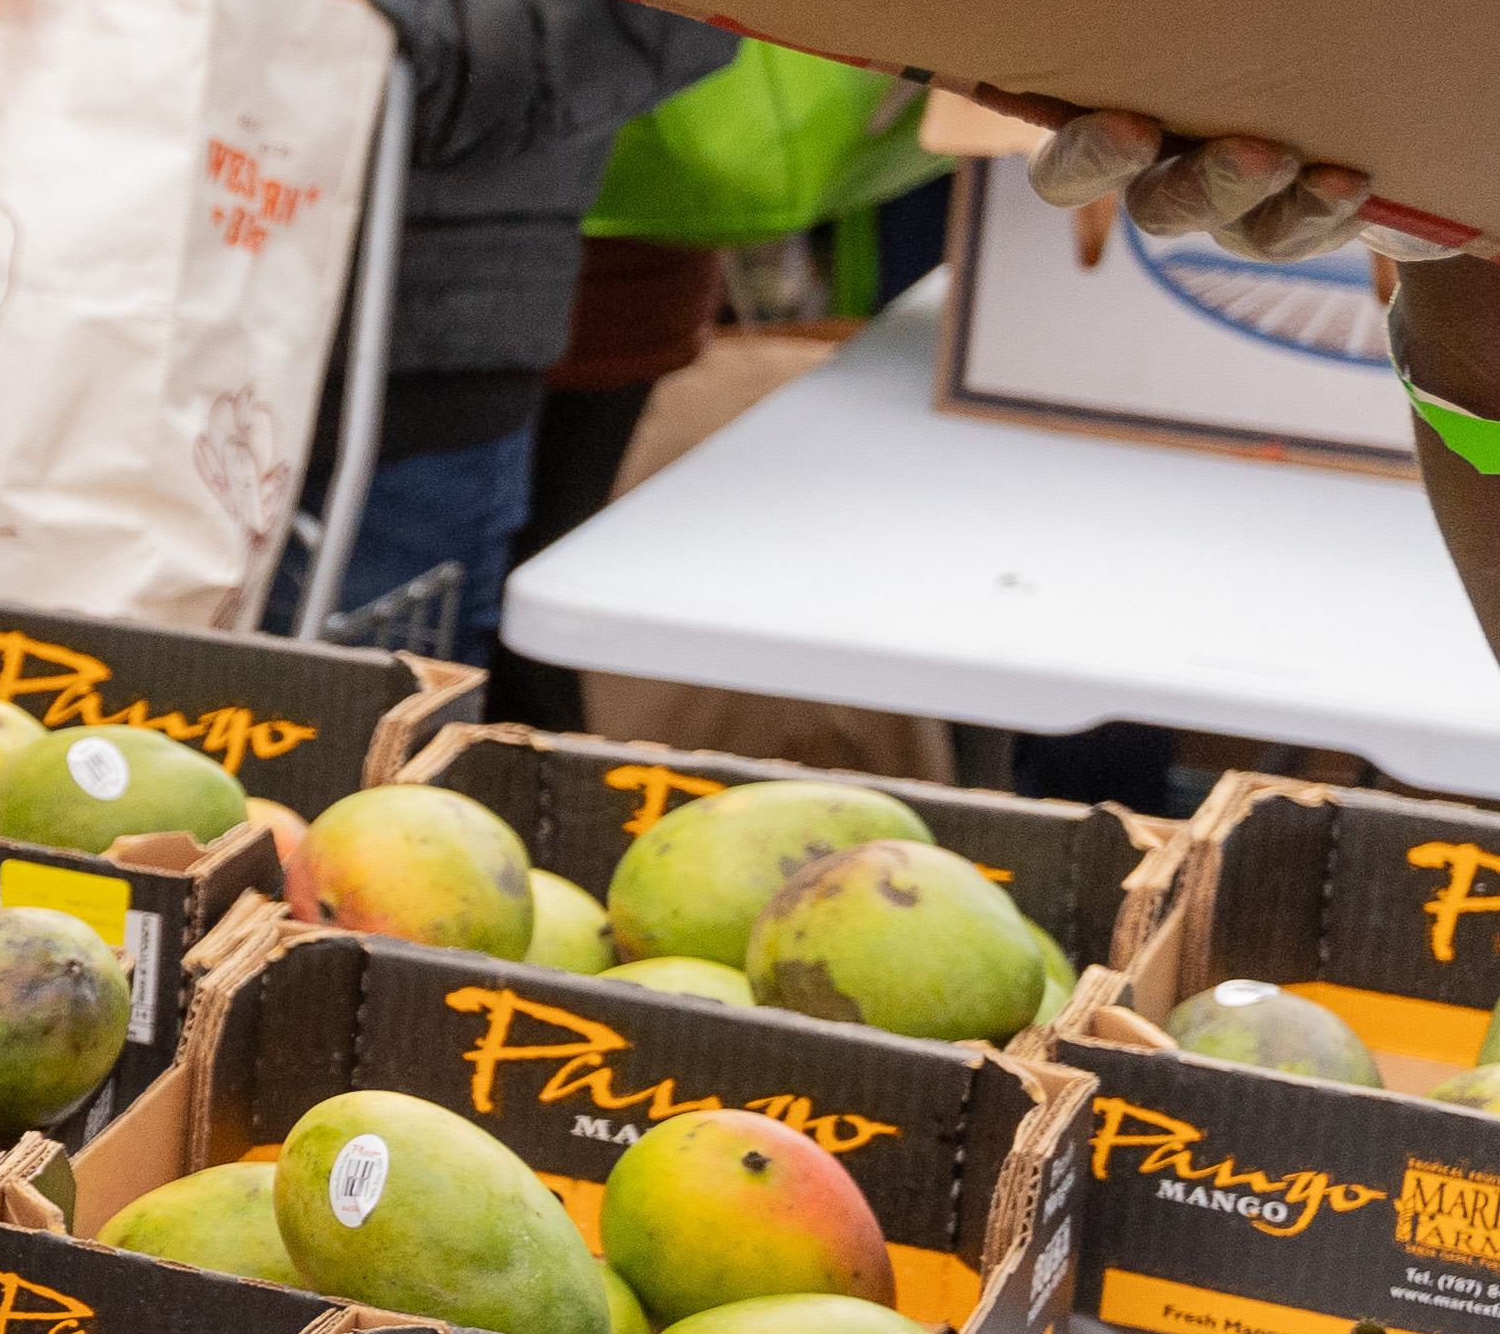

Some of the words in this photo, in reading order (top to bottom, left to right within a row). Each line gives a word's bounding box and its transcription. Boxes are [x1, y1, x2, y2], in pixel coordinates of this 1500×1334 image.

[1088, 1096, 1388, 1238] Pango
[1154, 1178, 1290, 1224] MANGO
[1161, 1302, 1217, 1331] Fresh
